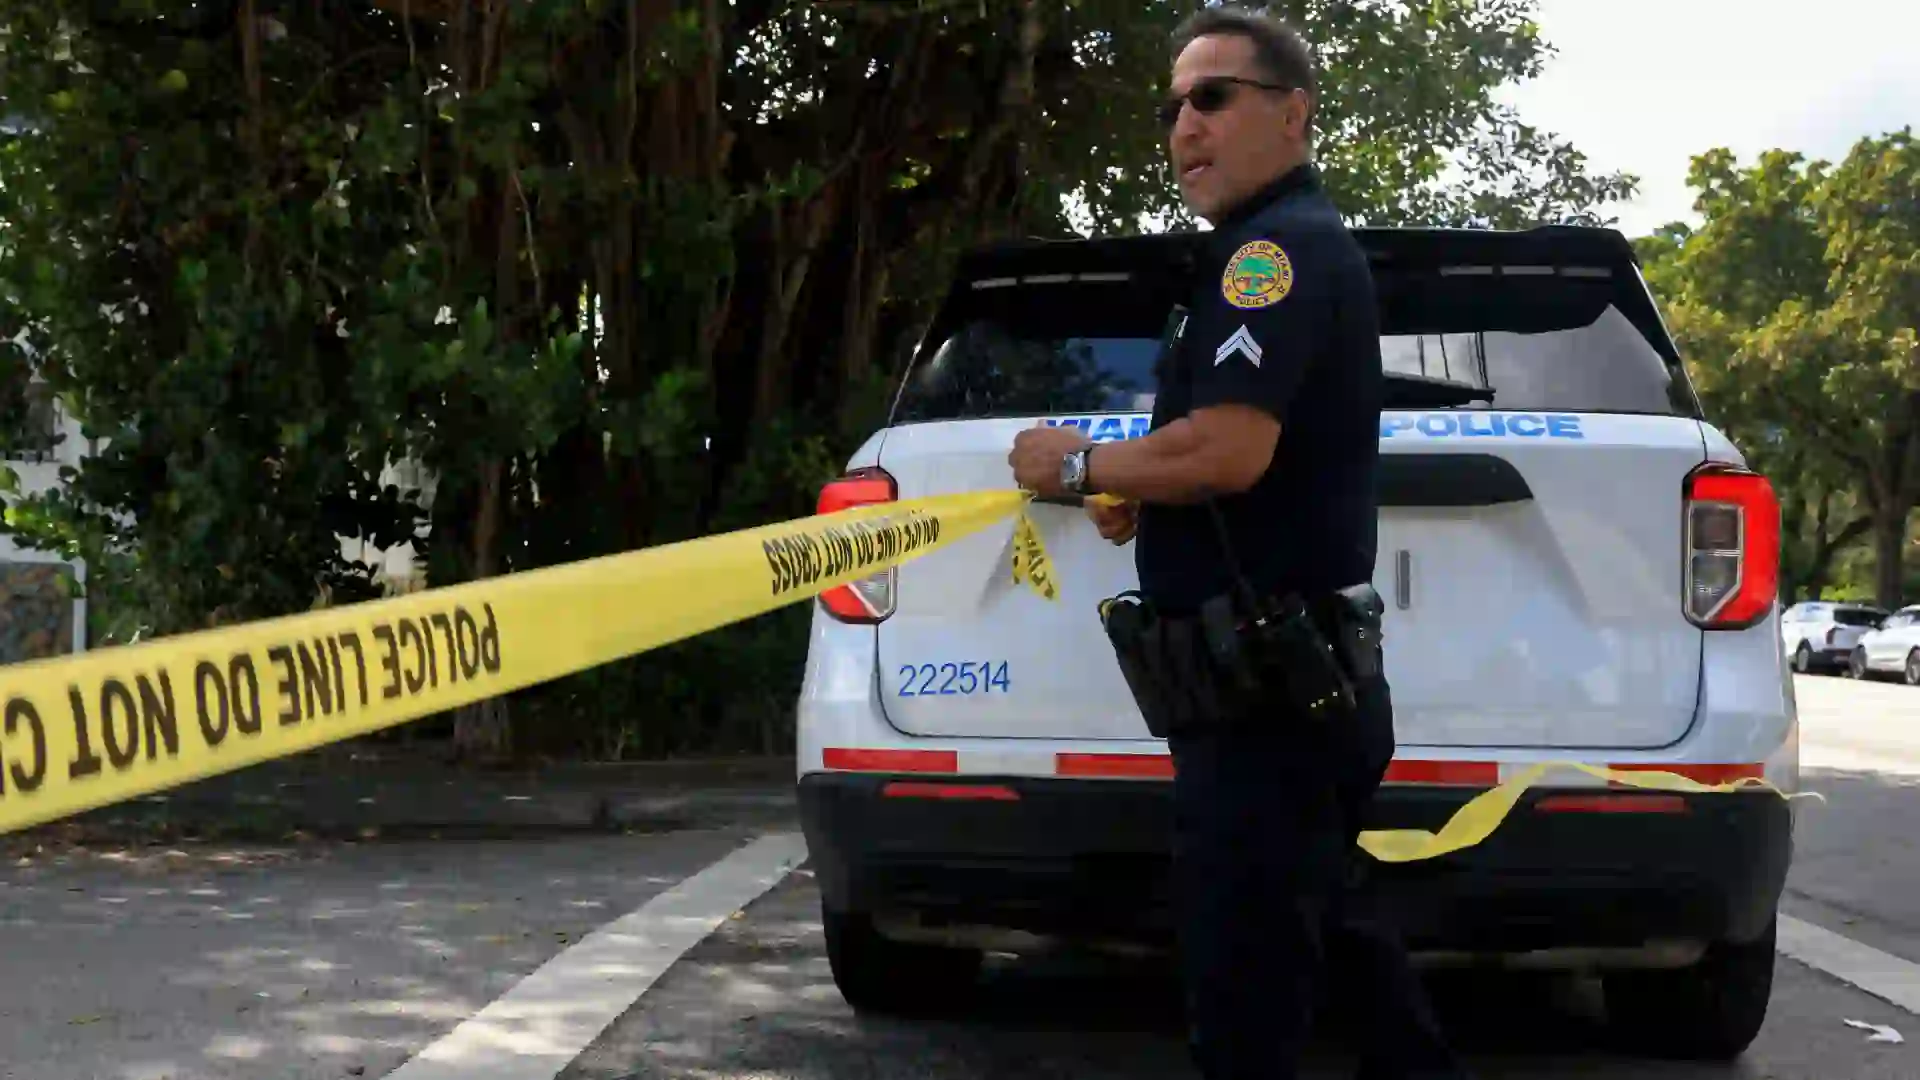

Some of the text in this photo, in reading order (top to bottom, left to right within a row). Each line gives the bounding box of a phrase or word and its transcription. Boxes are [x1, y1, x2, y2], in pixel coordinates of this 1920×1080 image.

[1380, 414, 1584, 438] POLICE
[762, 532, 822, 597] CROSS
[818, 526, 853, 577] NOT
[852, 520, 875, 569] DO
[269, 632, 370, 726] LINE
[373, 602, 501, 699] POLICE
[898, 660, 1011, 697] 222514
[68, 667, 180, 781] NOT
[194, 652, 263, 748] DO
